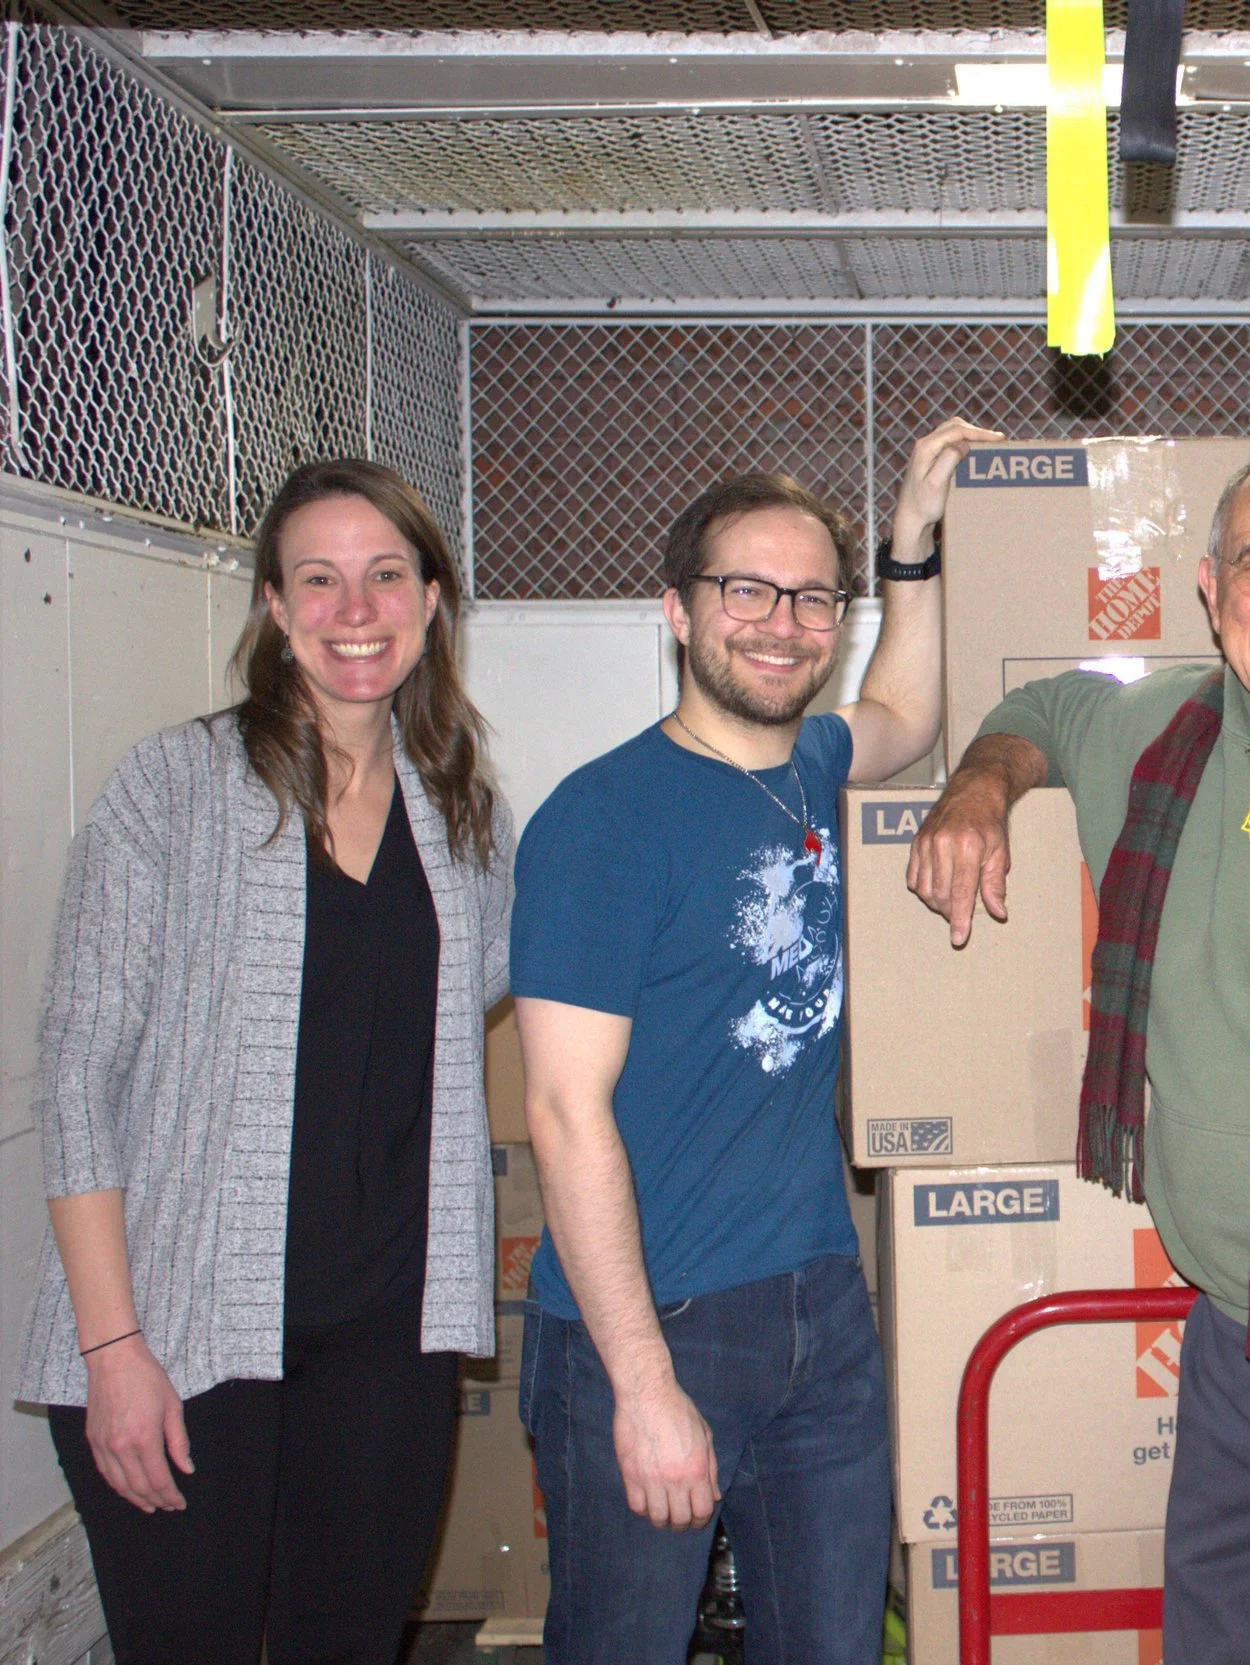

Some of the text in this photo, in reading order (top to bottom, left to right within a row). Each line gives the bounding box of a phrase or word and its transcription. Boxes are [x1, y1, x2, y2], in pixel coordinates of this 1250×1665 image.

[968, 455, 1075, 481] LARGE
[1089, 569, 1160, 641] HOME
[871, 1120, 909, 1132] MADE IN
[871, 1131, 909, 1153] USA
[928, 1187, 1045, 1218] LARGE
[1133, 1441, 1171, 1466] get
[991, 1509, 1068, 1522] YCLED PAPER
[1003, 1500, 1037, 1511] FROM
[1039, 1498, 1067, 1509] 100%
[946, 1550, 1061, 1581] LRGE
